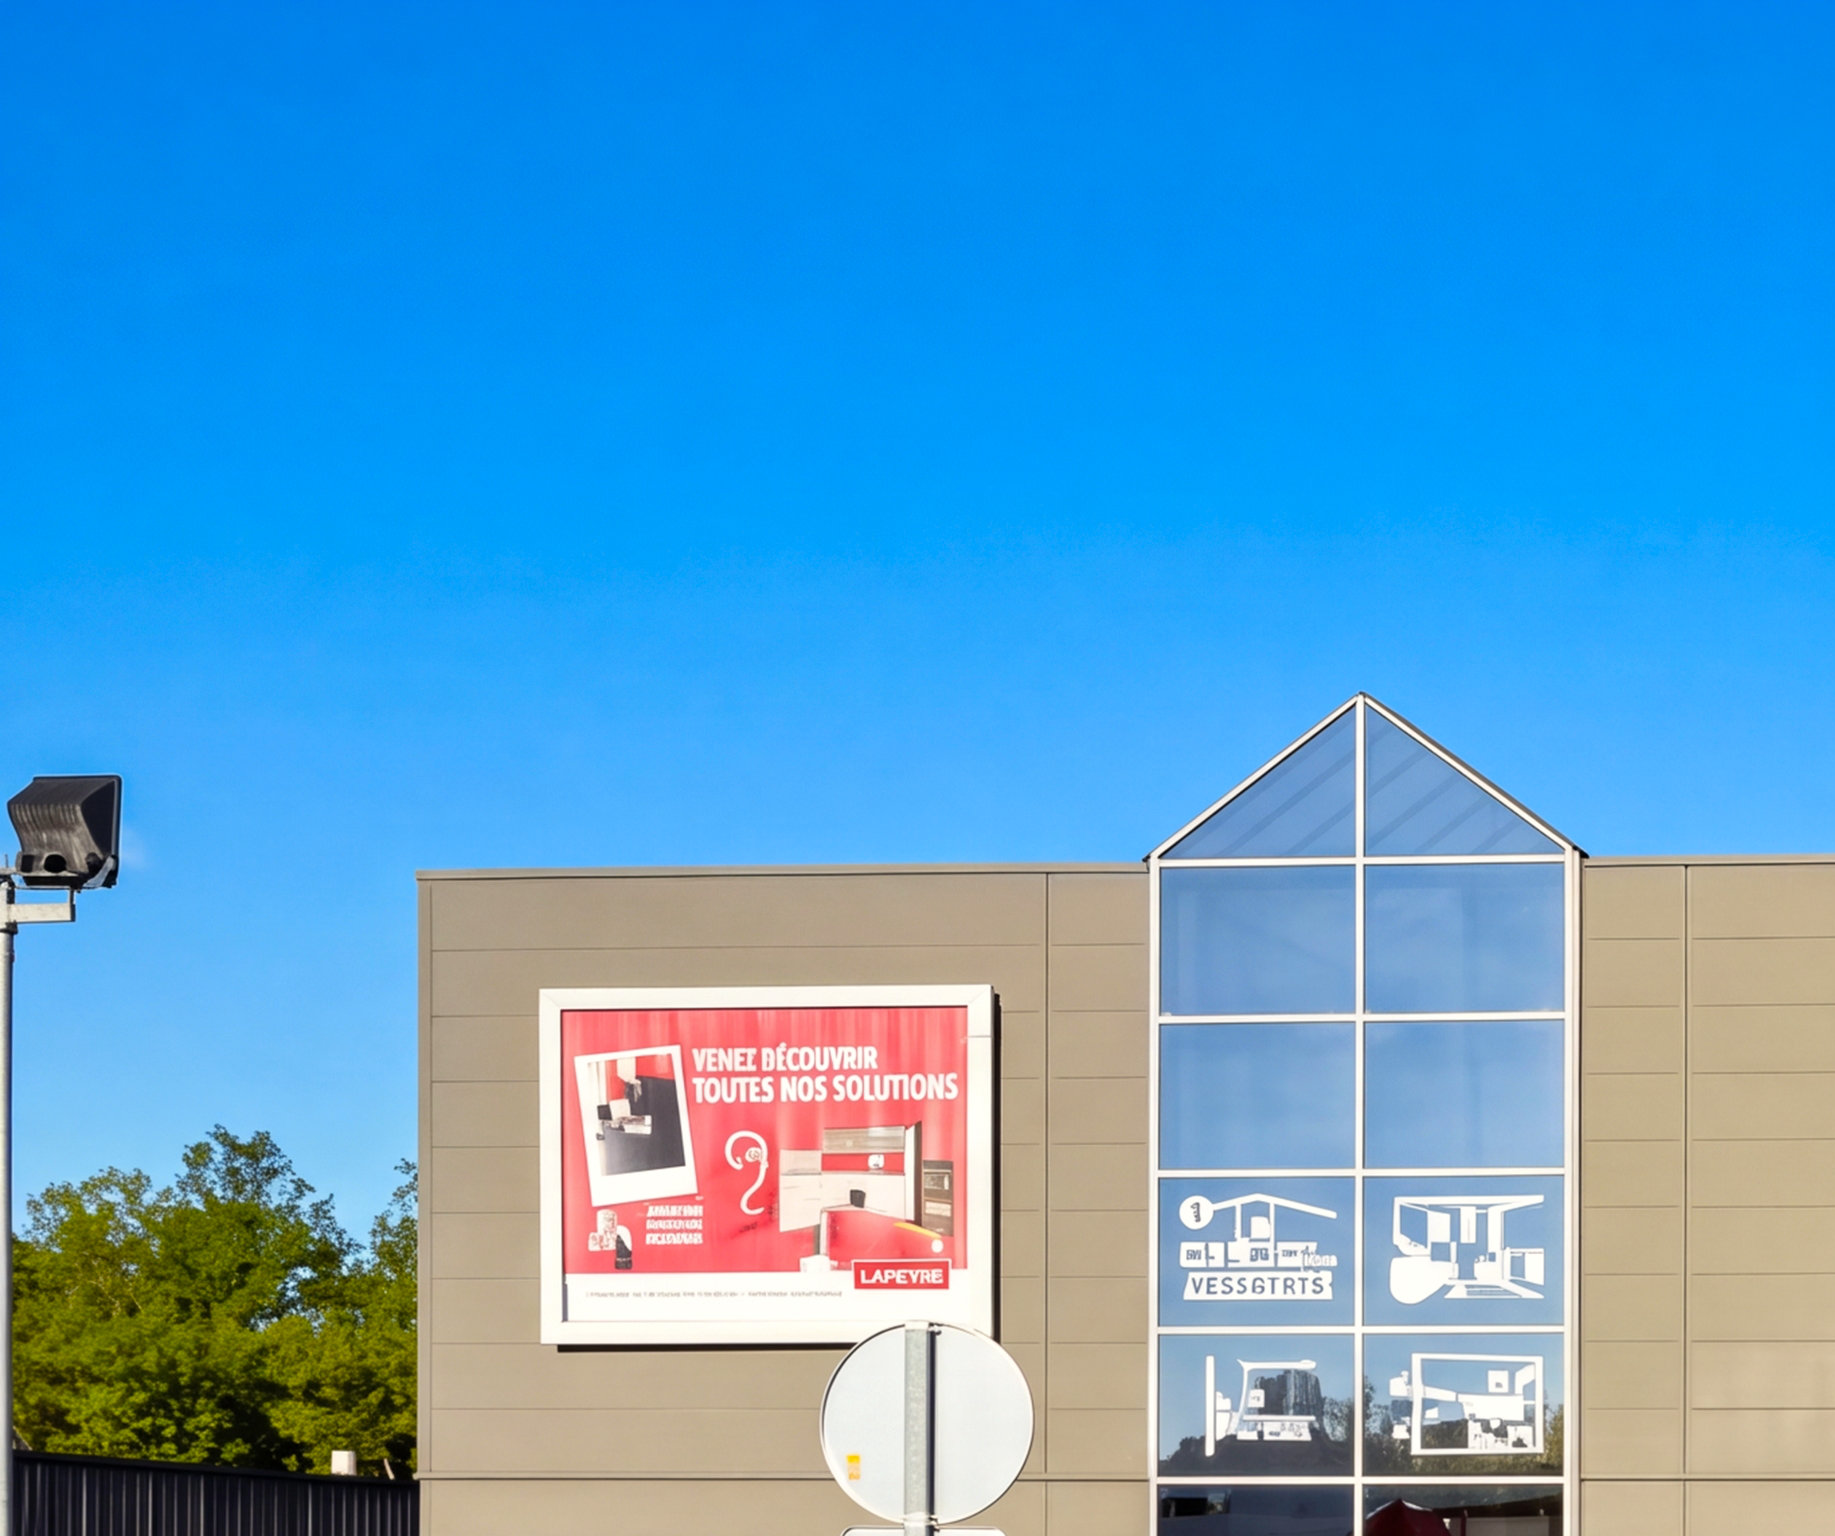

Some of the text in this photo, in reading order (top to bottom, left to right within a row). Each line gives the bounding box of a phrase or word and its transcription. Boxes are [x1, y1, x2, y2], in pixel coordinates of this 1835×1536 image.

[761, 1042, 879, 1072] DÉCOUVRIR
[691, 1072, 959, 1104] TOUTES NOS SOLUTIONS
[860, 1268, 944, 1285] LAPEYRE
